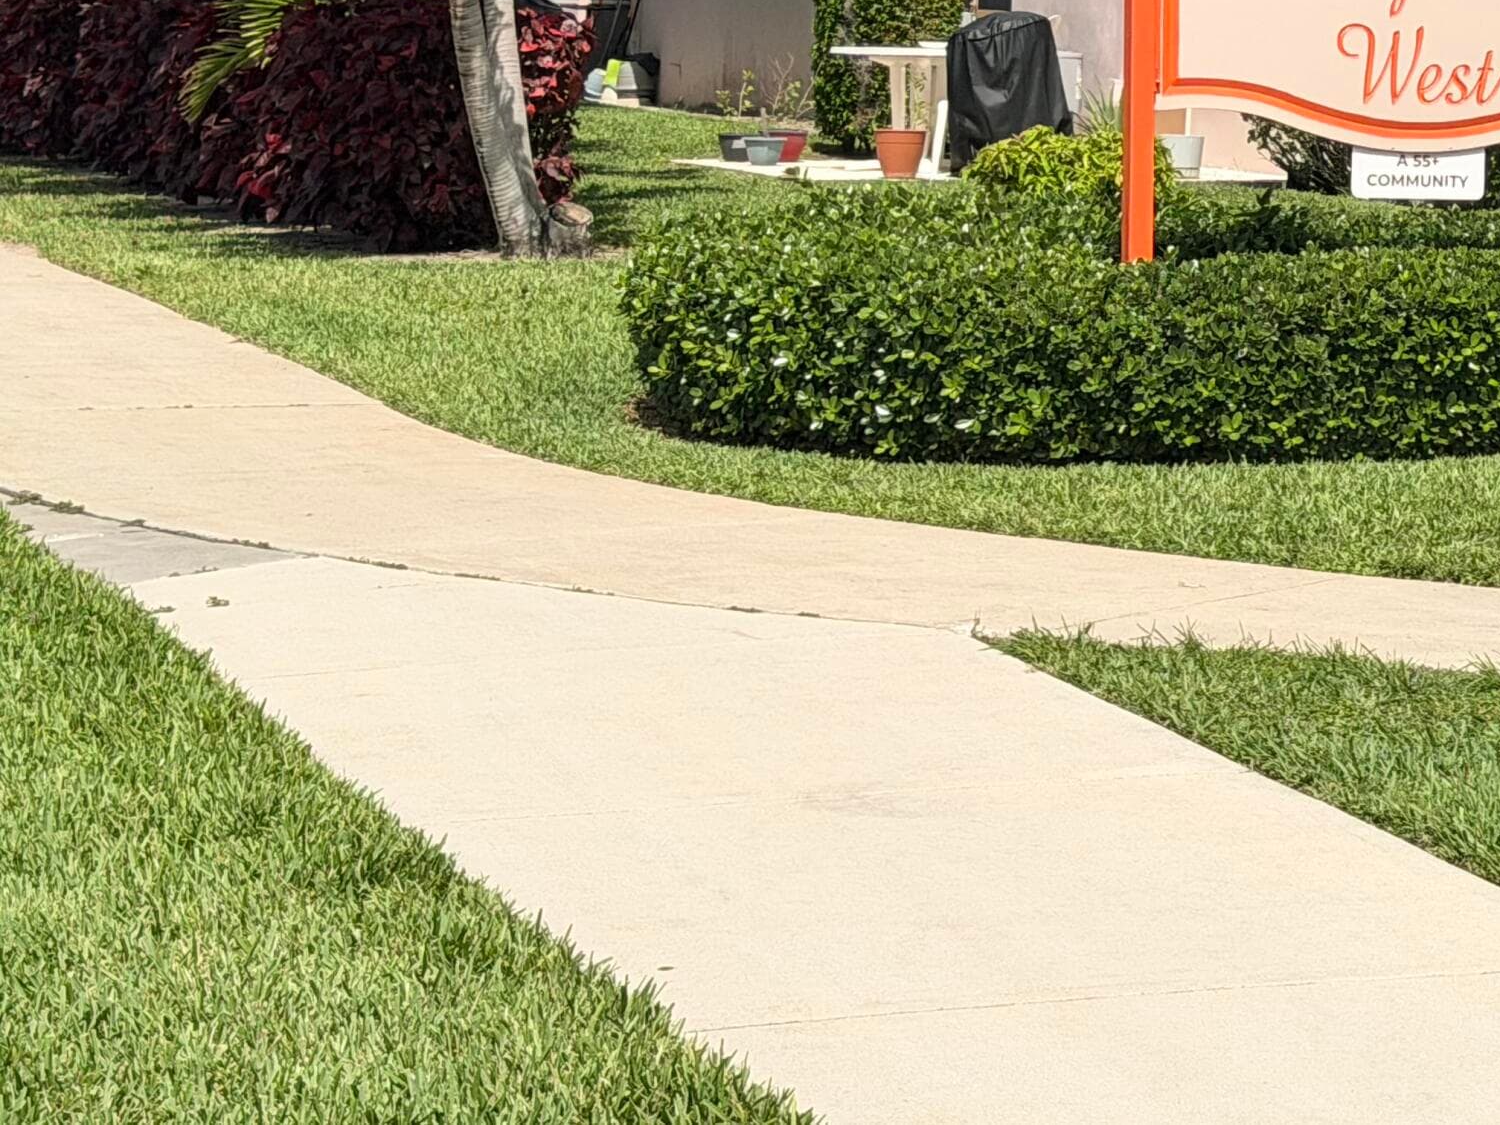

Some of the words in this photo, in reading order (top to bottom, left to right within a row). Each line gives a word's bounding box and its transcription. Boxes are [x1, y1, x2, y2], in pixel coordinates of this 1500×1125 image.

[1396, 155, 1408, 167] A
[1413, 155, 1439, 167] 55+
[1367, 174, 1468, 188] COMMUNITY
